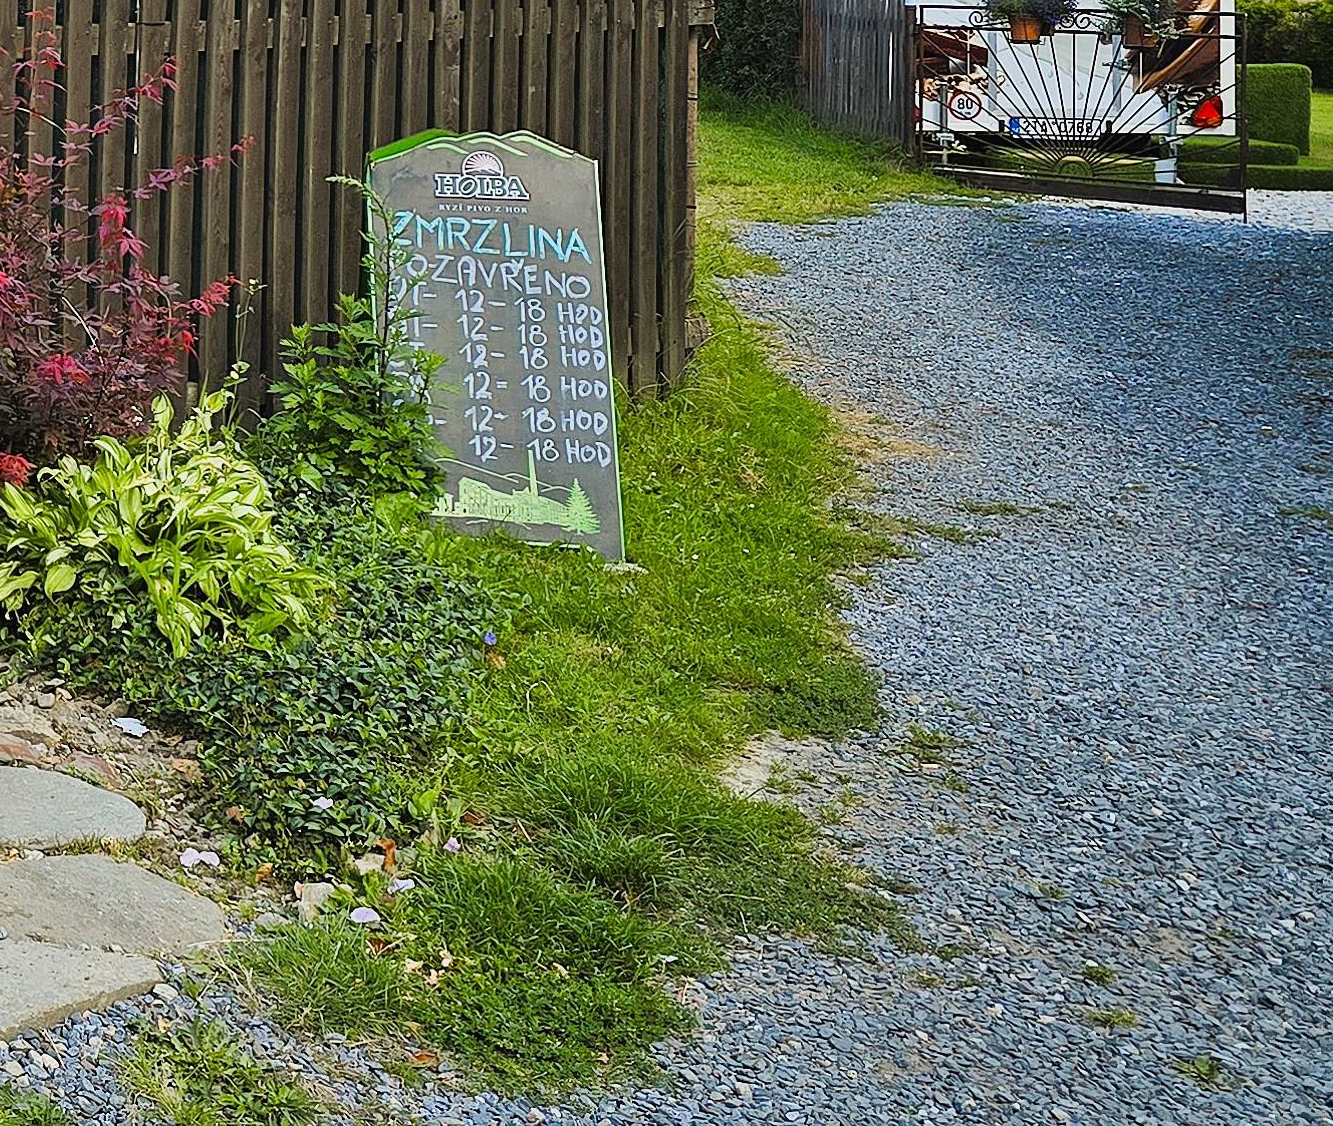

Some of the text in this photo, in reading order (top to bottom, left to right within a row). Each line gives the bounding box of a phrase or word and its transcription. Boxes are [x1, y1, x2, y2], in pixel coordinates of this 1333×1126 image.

[957, 97, 974, 110] 80
[436, 174, 530, 200] HOLBA
[467, 204, 491, 213] PIVO
[505, 206, 528, 214] HOR
[390, 210, 593, 264] ZMRZLINA
[557, 302, 602, 325] HOD
[559, 324, 604, 348] HOD
[560, 345, 606, 371] HOD
[560, 376, 607, 400] HOD
[561, 409, 608, 436] HOD
[565, 438, 611, 467] HOD
